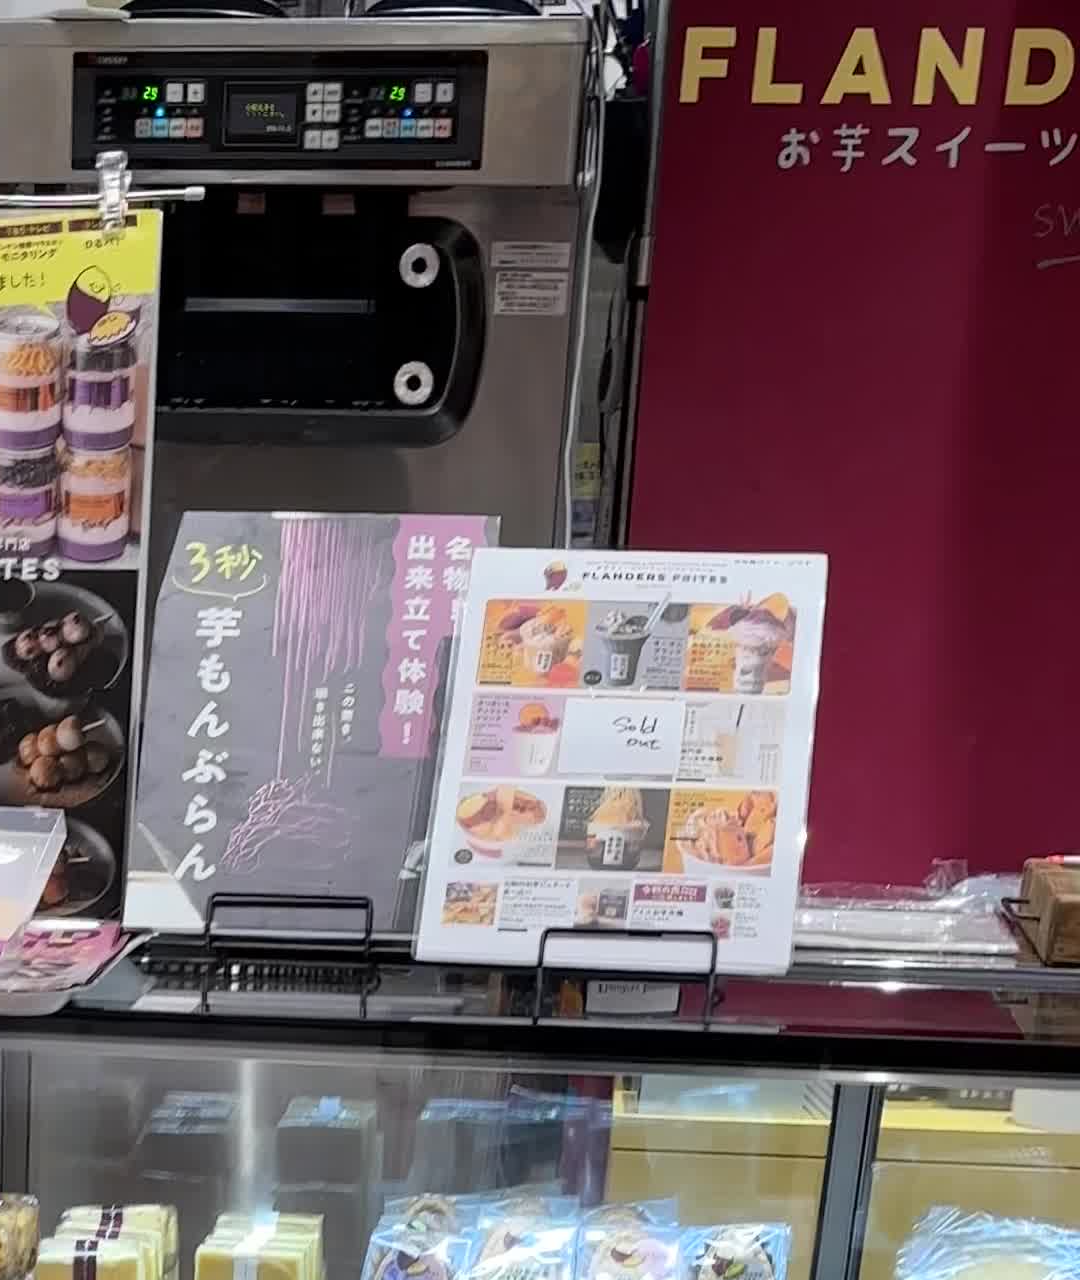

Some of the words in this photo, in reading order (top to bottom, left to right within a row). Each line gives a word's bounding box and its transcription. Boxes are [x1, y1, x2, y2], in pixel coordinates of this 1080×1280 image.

[679, 26, 1076, 106] FLAND
[777, 123, 1078, 172] お芋スイーツ
[186, 542, 262, 584] 3秒
[393, 534, 435, 745] 出来立て体験！
[174, 606, 242, 882] 芋もんぶらん
[613, 715, 657, 735] Sold
[626, 737, 663, 751] out
